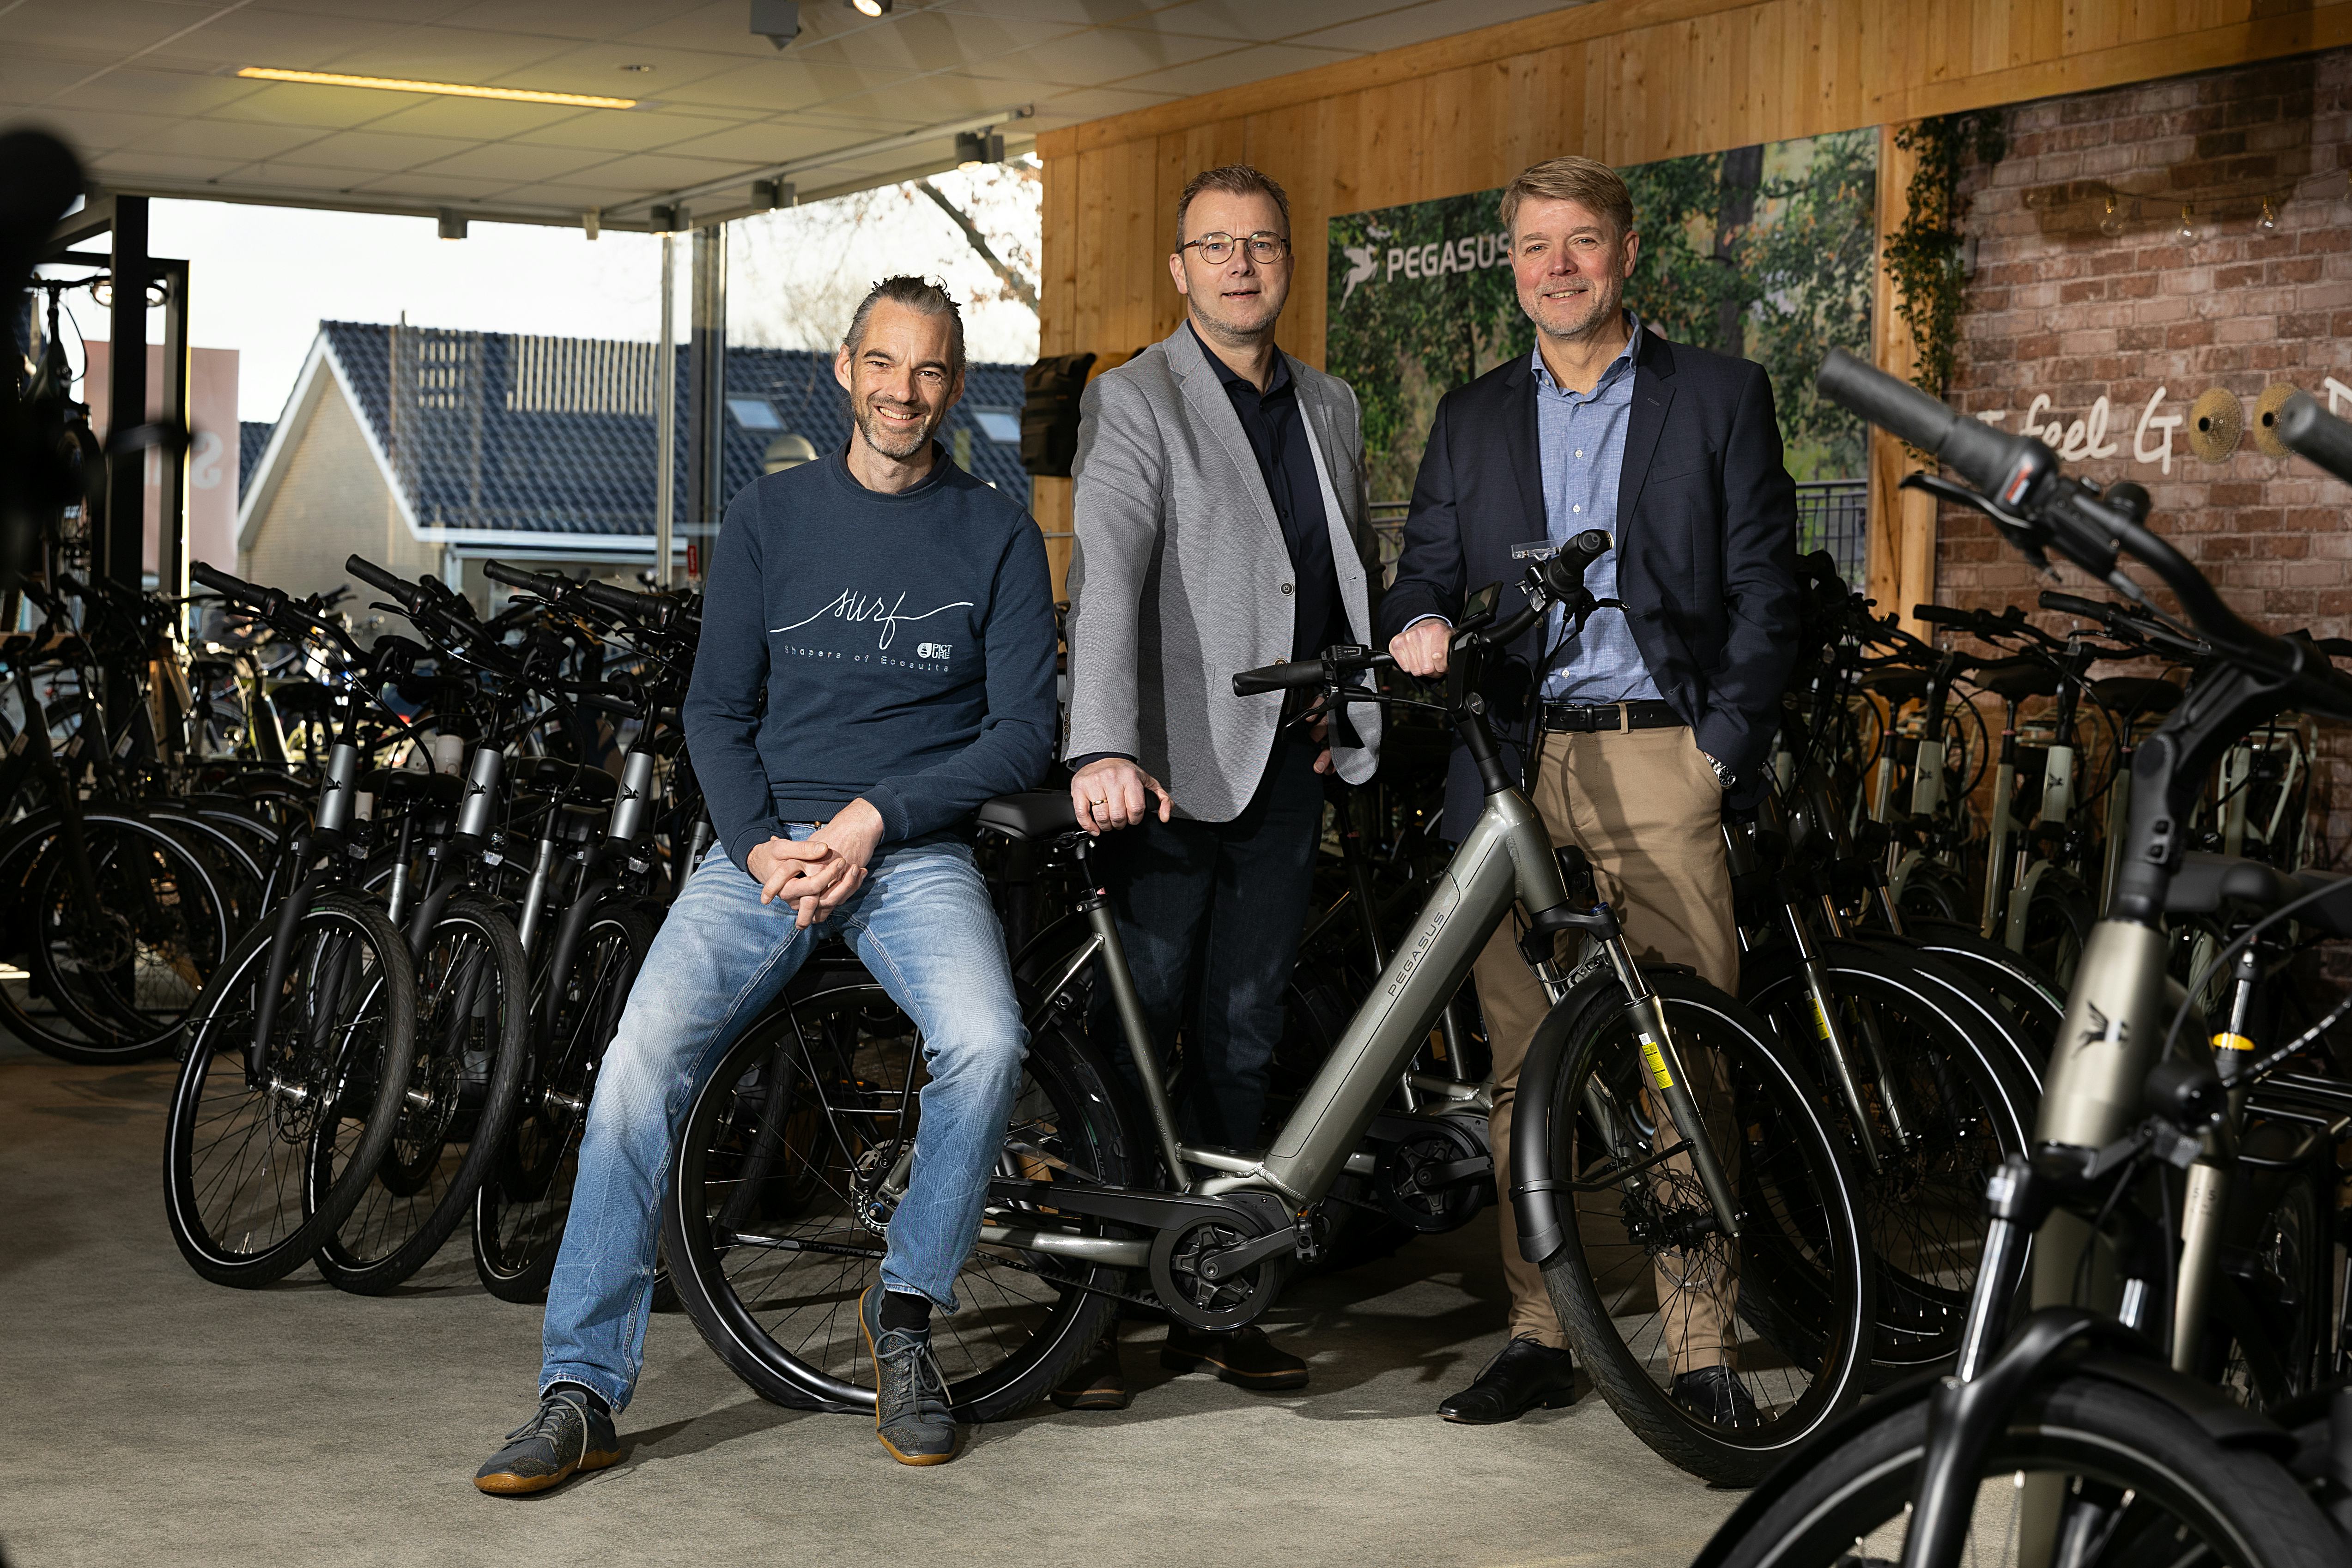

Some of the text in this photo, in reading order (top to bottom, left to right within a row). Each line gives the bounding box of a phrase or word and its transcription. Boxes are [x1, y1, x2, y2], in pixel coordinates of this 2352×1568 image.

[785, 645, 842, 659] Shapers
[854, 654, 869, 663] of
[933, 643, 953, 652] PICT
[1388, 912, 1444, 996] PEGASUS
[1095, 1148, 1105, 1176] PLUS
